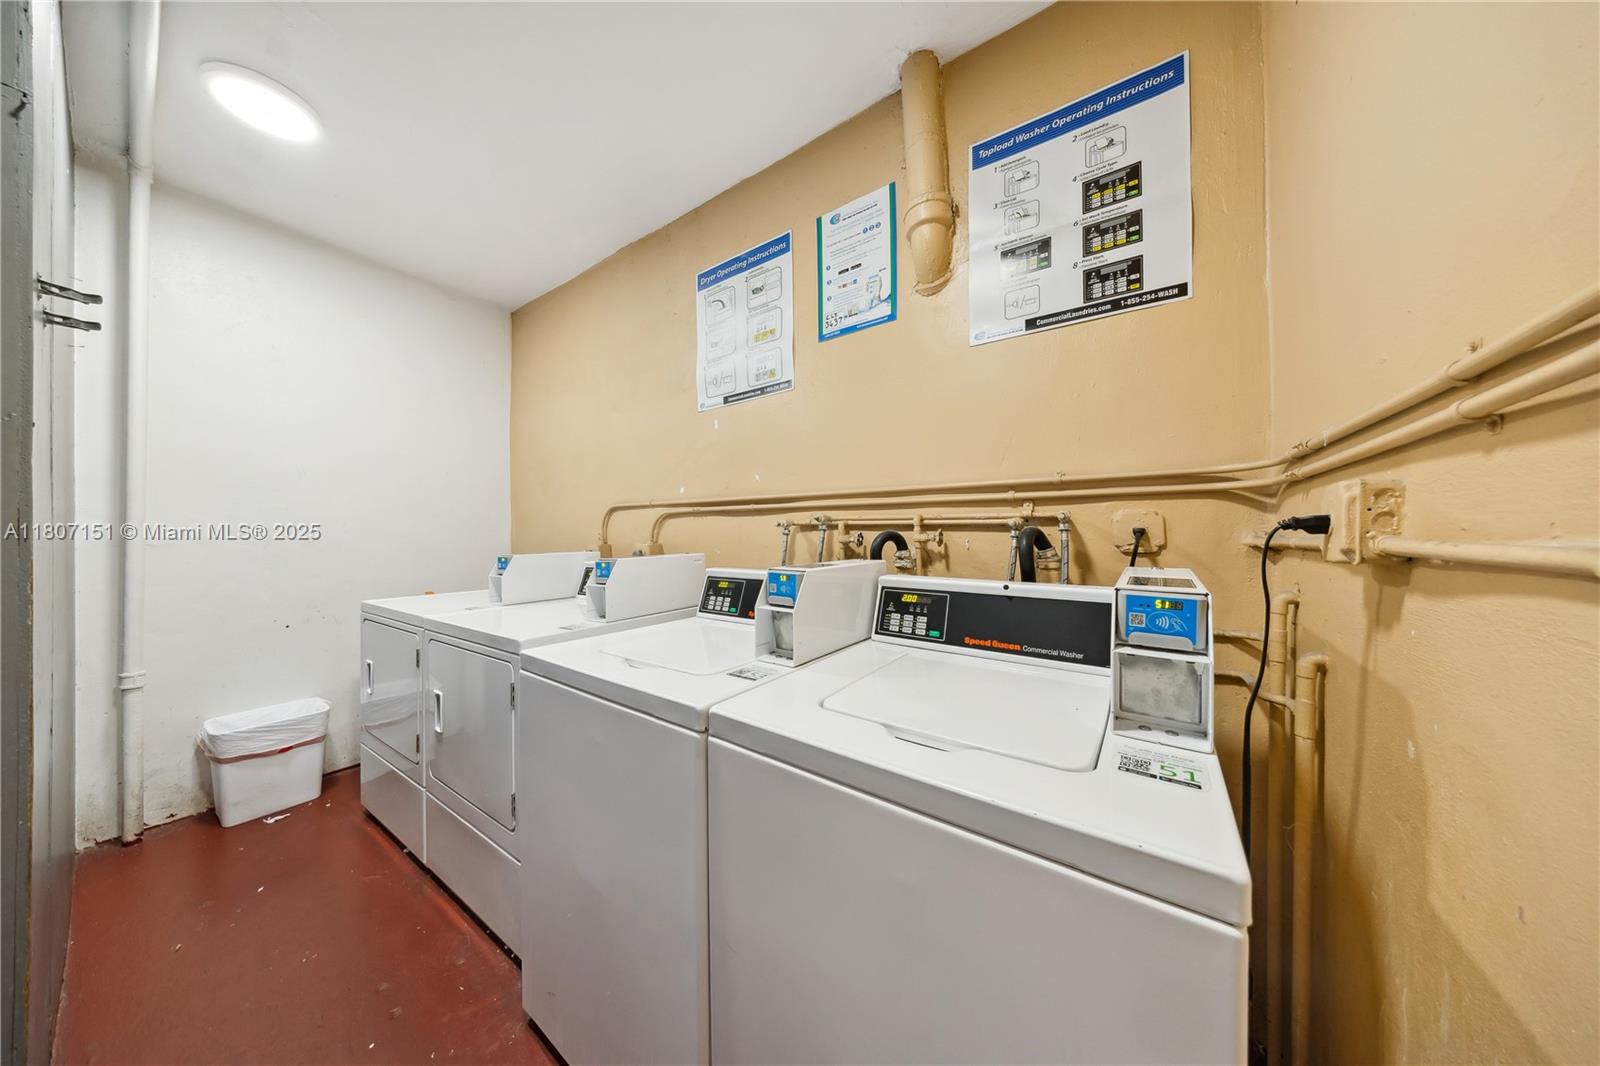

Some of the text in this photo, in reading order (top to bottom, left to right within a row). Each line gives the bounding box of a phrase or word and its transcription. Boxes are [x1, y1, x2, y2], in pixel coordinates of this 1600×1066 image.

[978, 69, 1175, 158] Topload Washer Operating Instructions
[700, 274, 716, 286] Dryer
[716, 260, 747, 278] Operating
[747, 241, 787, 264] Instructions
[1036, 287, 1179, 326] CommercialLaundries.com 1-855-254-WASH
[964, 636, 1084, 660] Speed Queen Commercial Washer
[1159, 764, 1201, 784] 51
